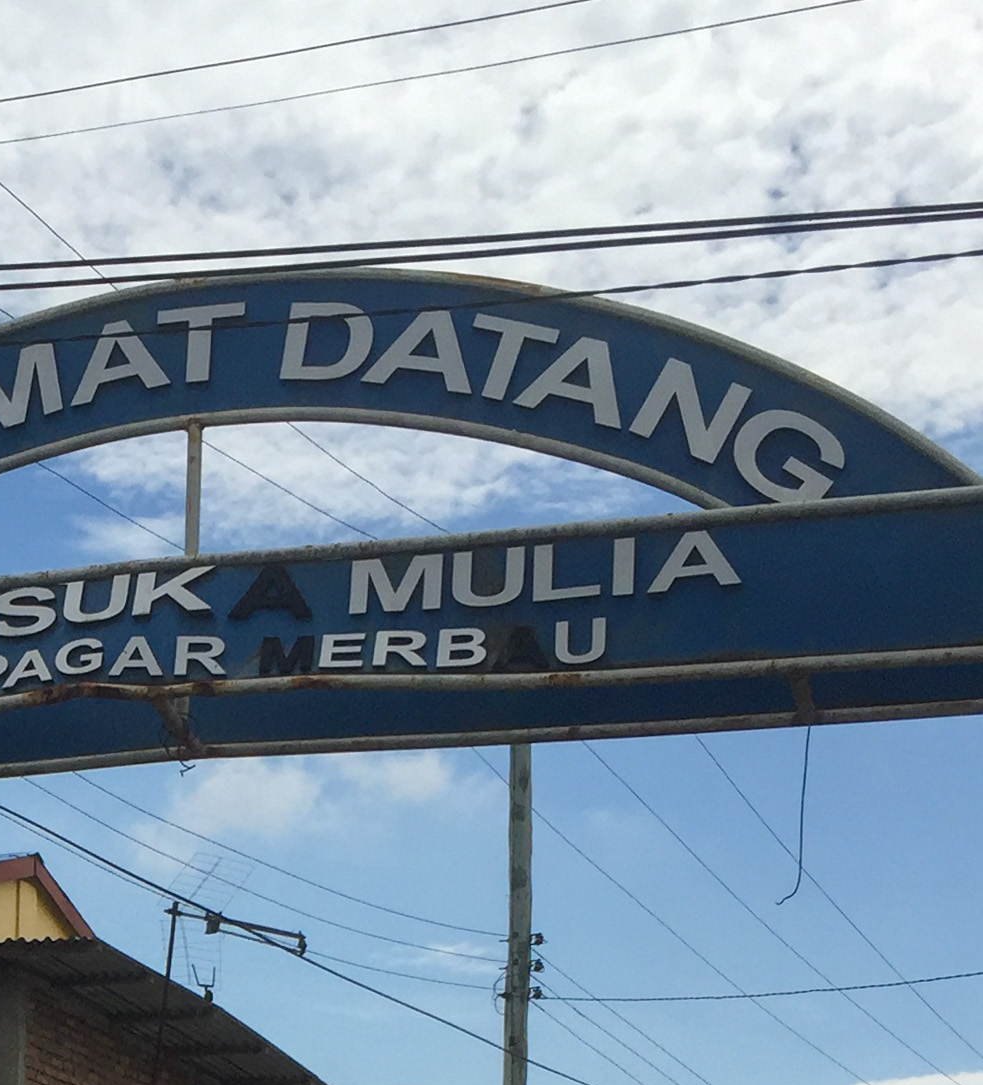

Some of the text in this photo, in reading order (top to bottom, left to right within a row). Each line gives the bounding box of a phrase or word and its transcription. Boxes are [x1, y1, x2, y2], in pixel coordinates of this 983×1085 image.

[279, 301, 845, 502] DATANG
[349, 530, 742, 615] MULIA
[259, 617, 606, 677] MERBAU
